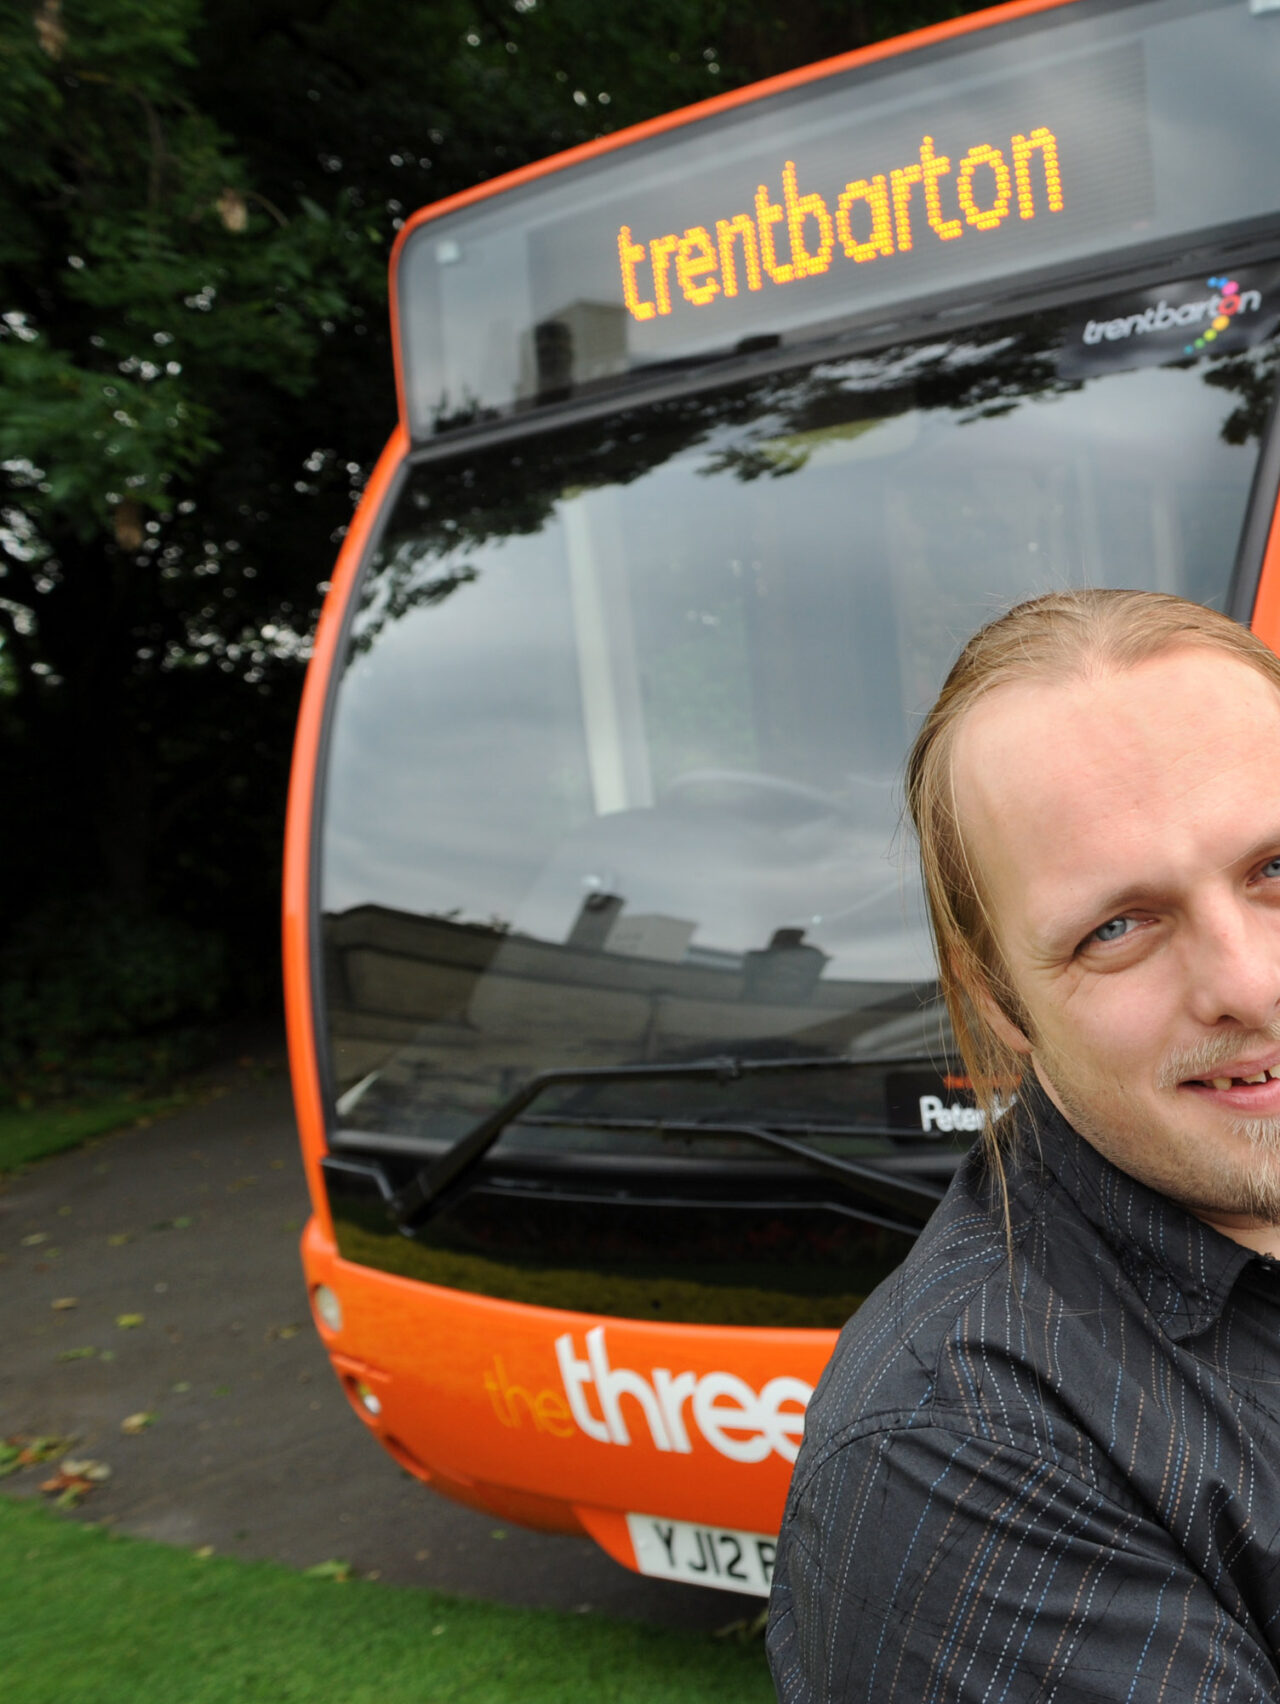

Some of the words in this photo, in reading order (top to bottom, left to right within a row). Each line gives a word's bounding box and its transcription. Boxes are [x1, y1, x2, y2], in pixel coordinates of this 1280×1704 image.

[617, 126, 1064, 321] trentbarton
[1083, 290, 1262, 345] trentbarton
[483, 1353, 575, 1438] the
[554, 1326, 816, 1466] three
[652, 1521, 748, 1581] YJ12
